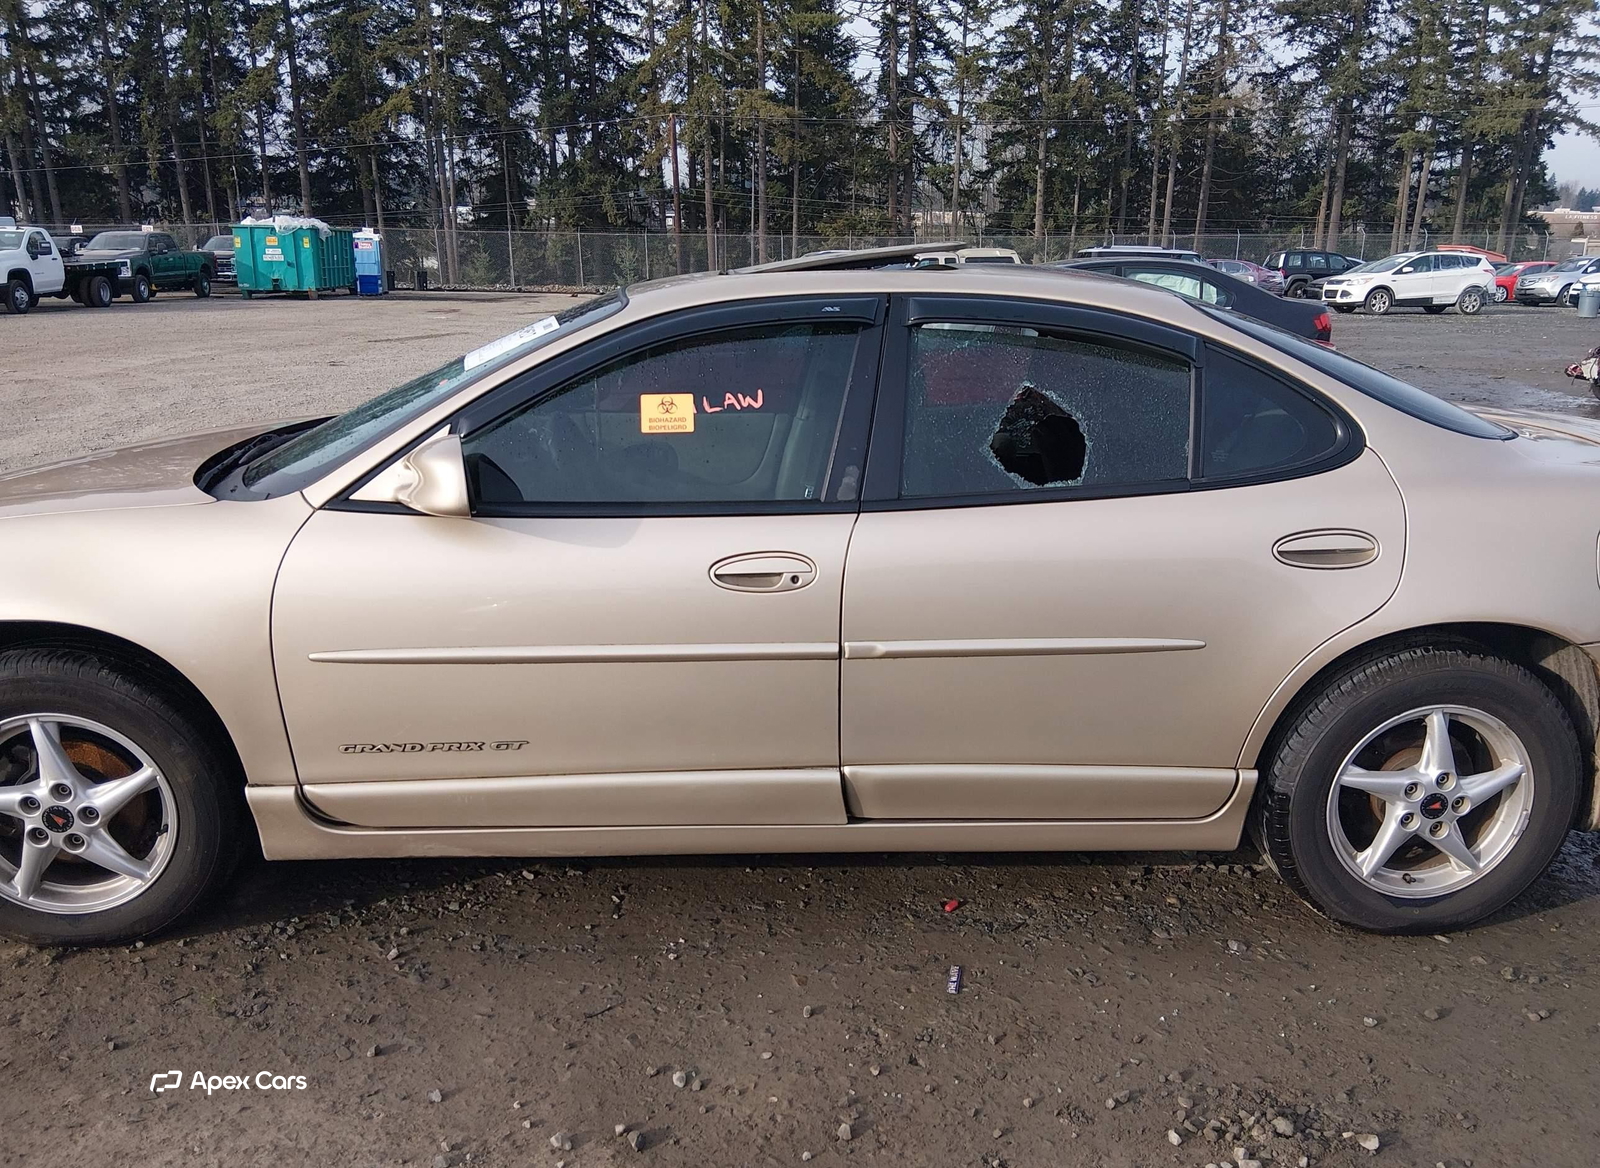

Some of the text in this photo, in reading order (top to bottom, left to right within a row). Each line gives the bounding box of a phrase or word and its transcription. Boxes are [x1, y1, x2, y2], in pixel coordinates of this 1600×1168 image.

[703, 389, 763, 413] LAW
[338, 740, 530, 754] GRAND PRIX GT
